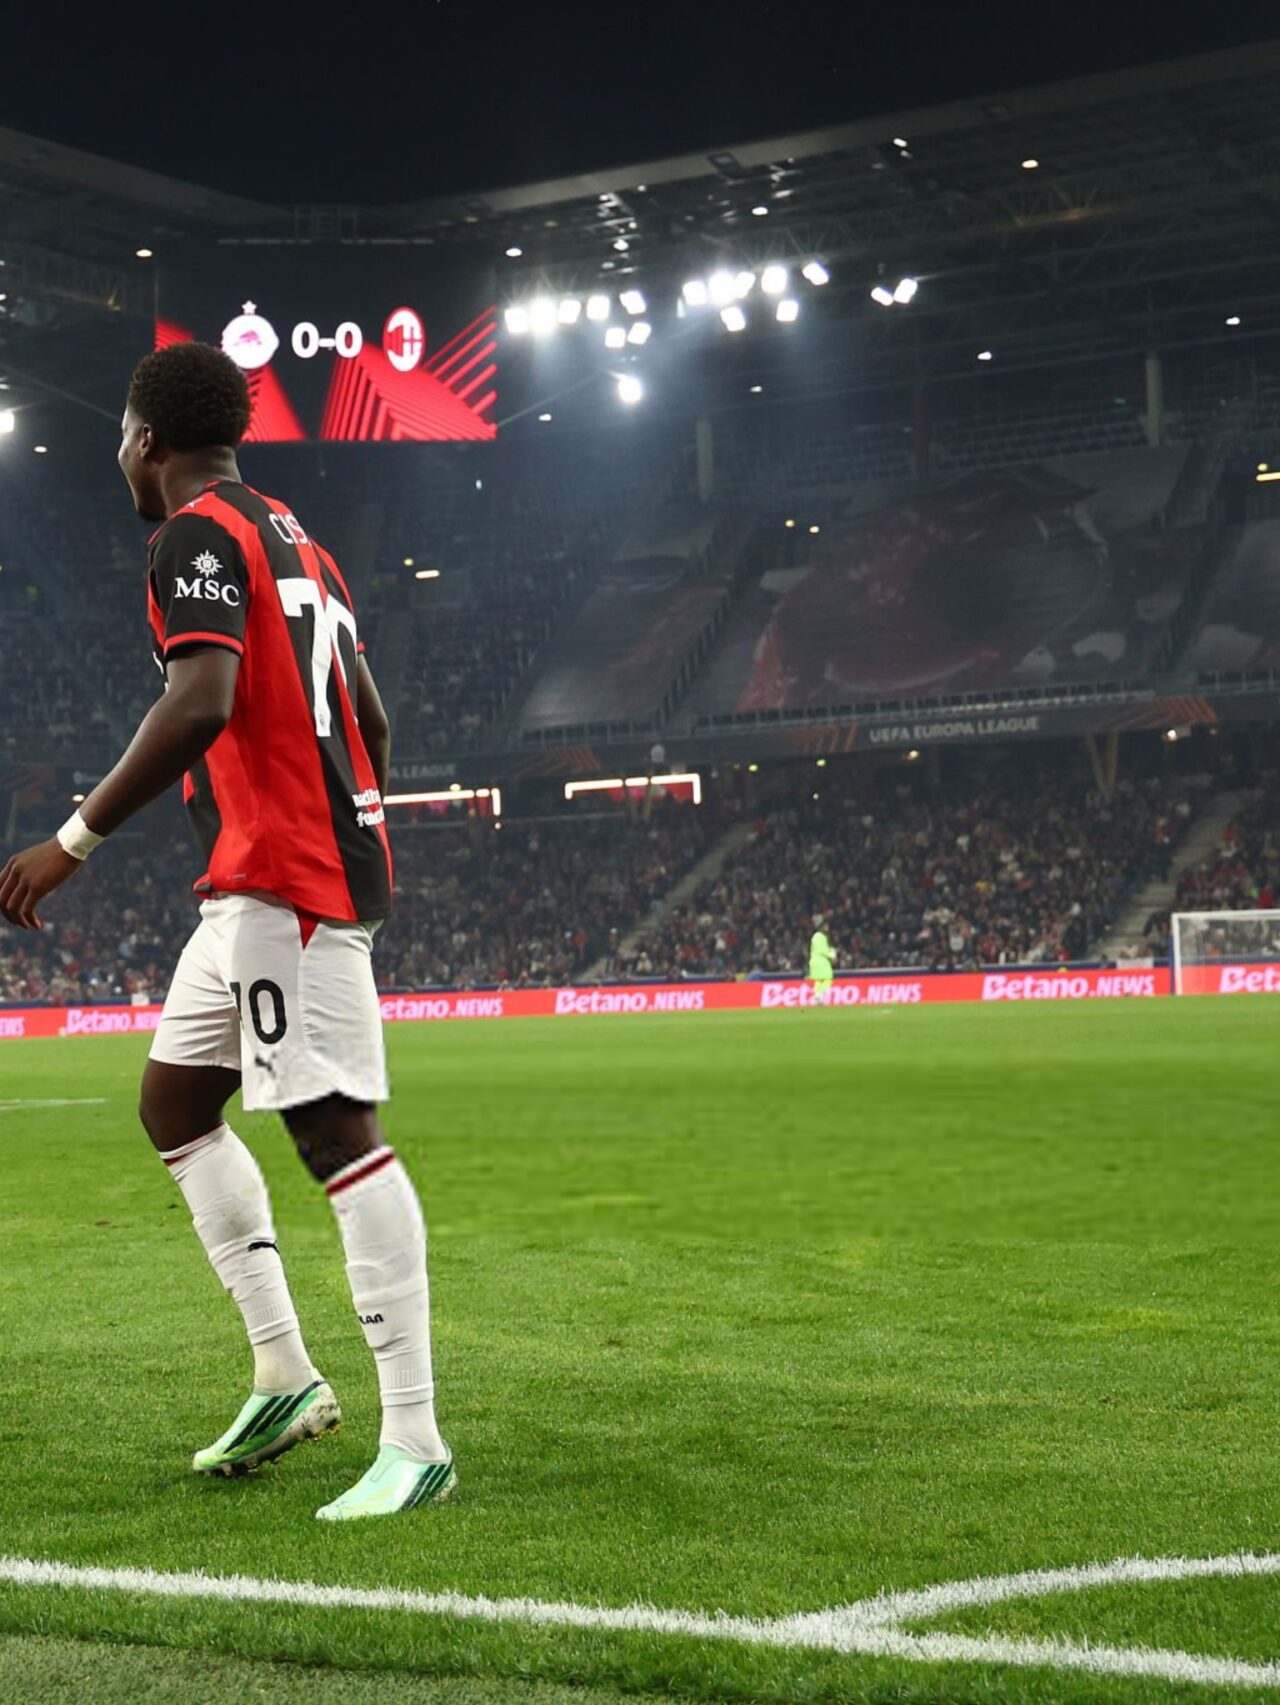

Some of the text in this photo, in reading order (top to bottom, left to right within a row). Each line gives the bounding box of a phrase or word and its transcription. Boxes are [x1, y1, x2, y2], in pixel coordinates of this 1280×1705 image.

[291, 321, 363, 358] 0-0
[268, 512, 313, 548] CIS
[174, 576, 240, 607] MSC
[870, 717, 1039, 743] UEFA EUROPA LEAGUE
[379, 998, 504, 1021] etano.NEWS
